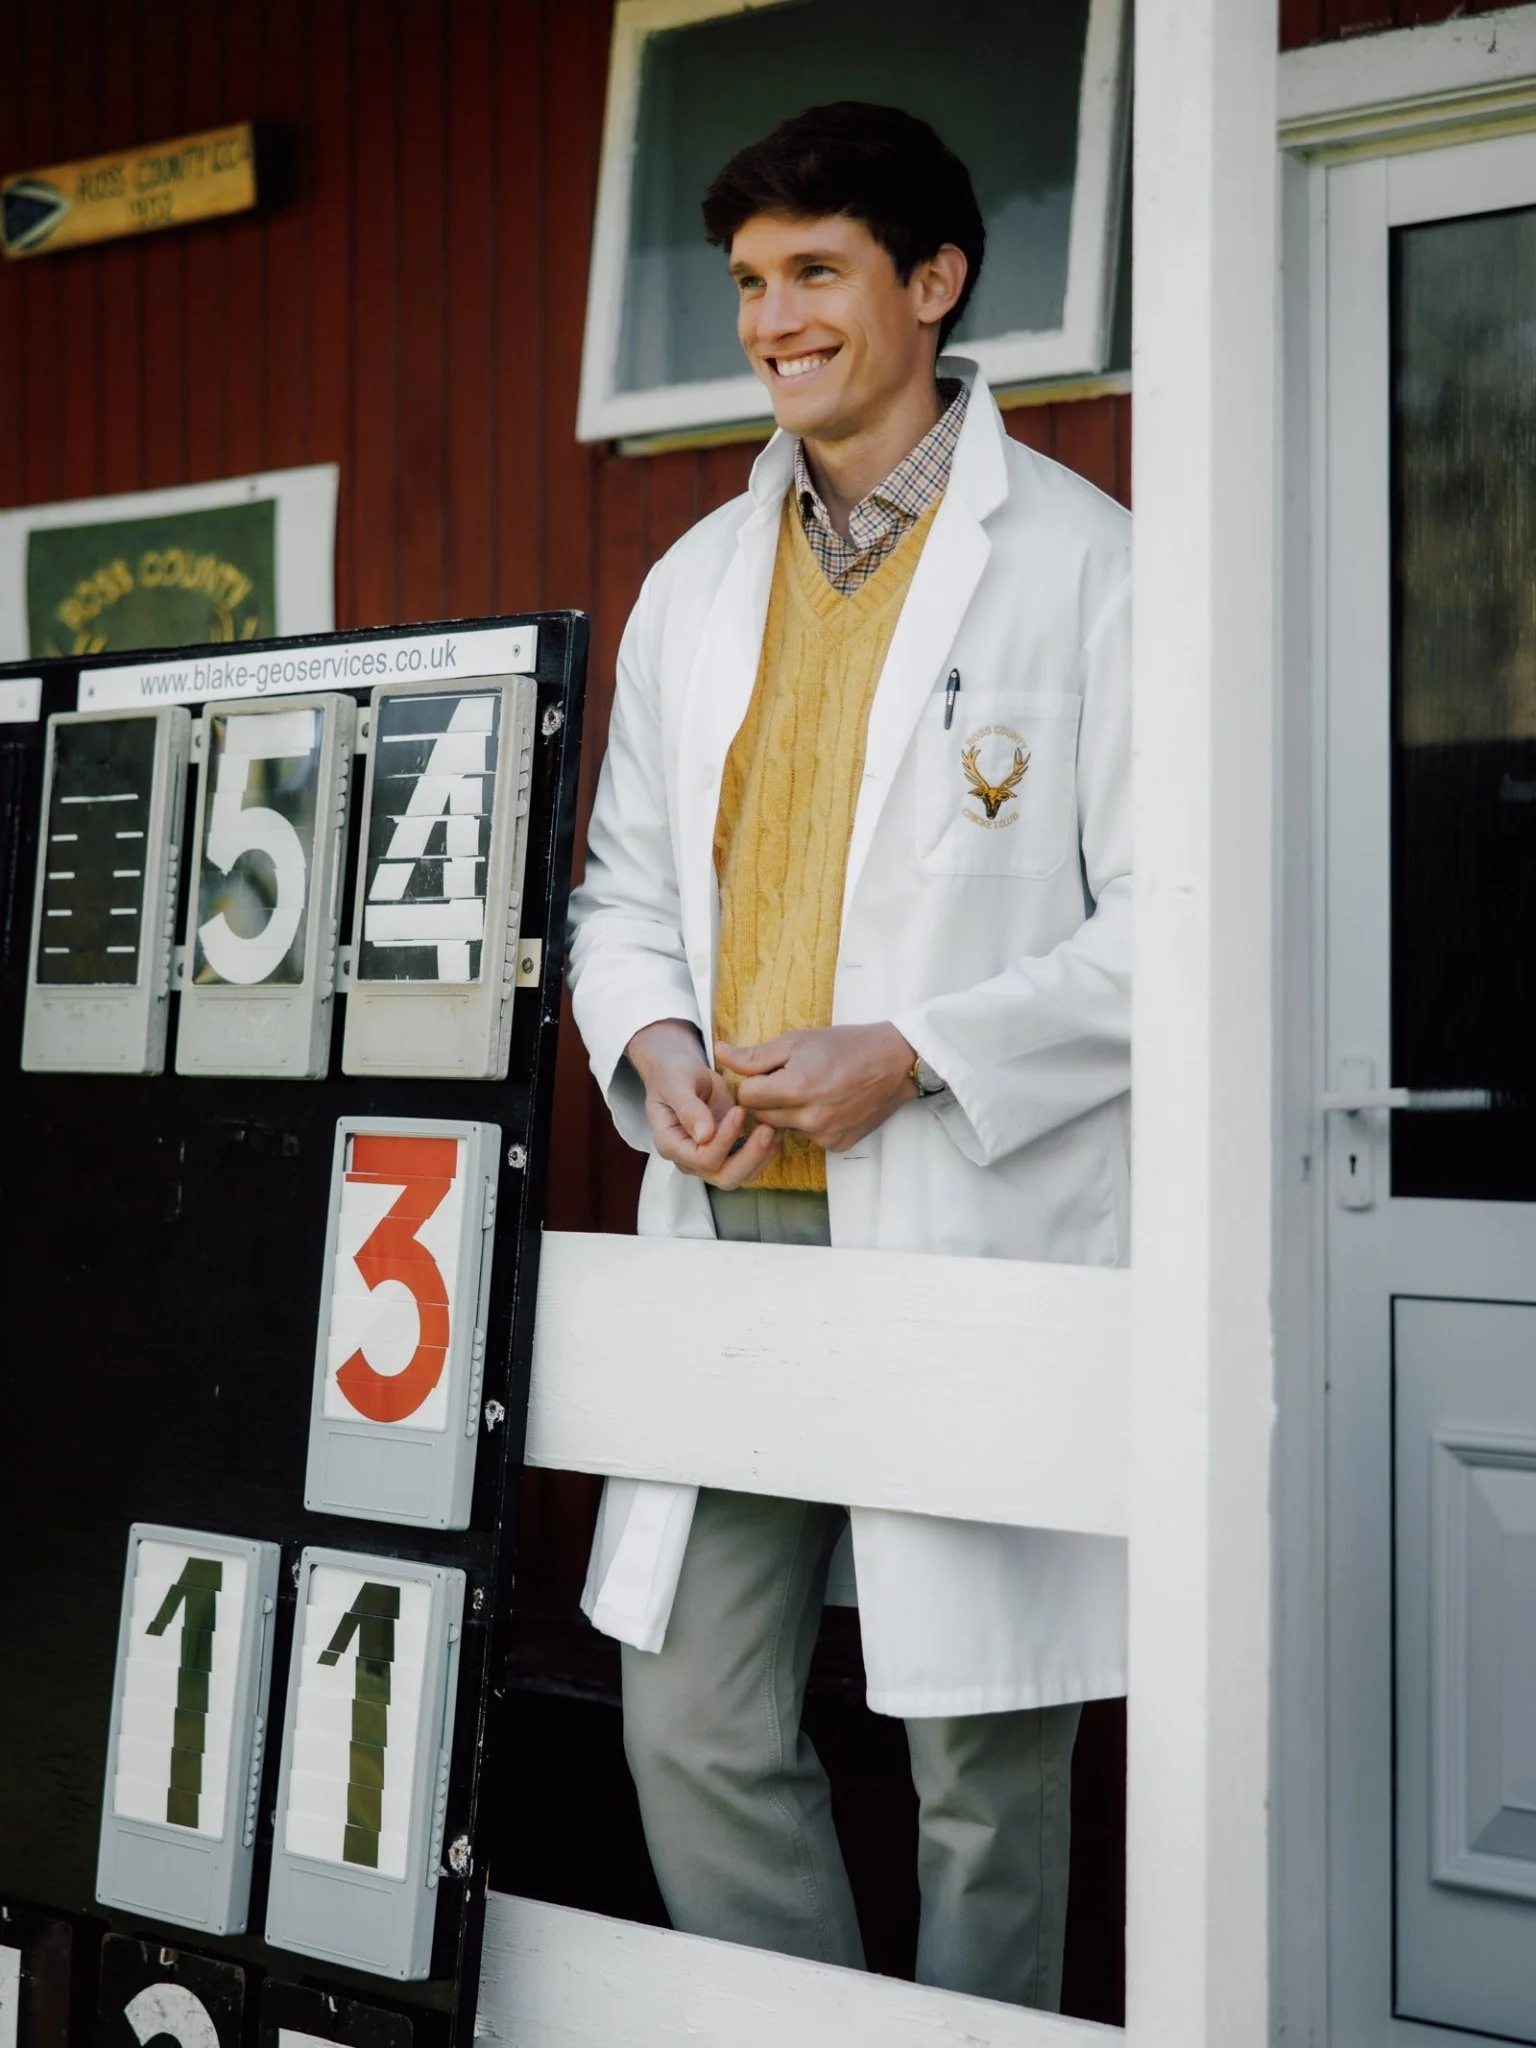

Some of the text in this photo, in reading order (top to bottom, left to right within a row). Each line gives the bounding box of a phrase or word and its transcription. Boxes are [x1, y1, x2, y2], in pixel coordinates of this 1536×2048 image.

[78, 163, 126, 201] ROSS
[133, 143, 207, 193] COUNTY
[137, 546, 252, 610] COUNTY
[140, 638, 457, 696] www.blake-geoservices.co.uk
[965, 724, 1028, 750] ROSS COUNTY
[961, 807, 1020, 831] CRICKET CLUB
[336, 1135, 458, 1423] 3
